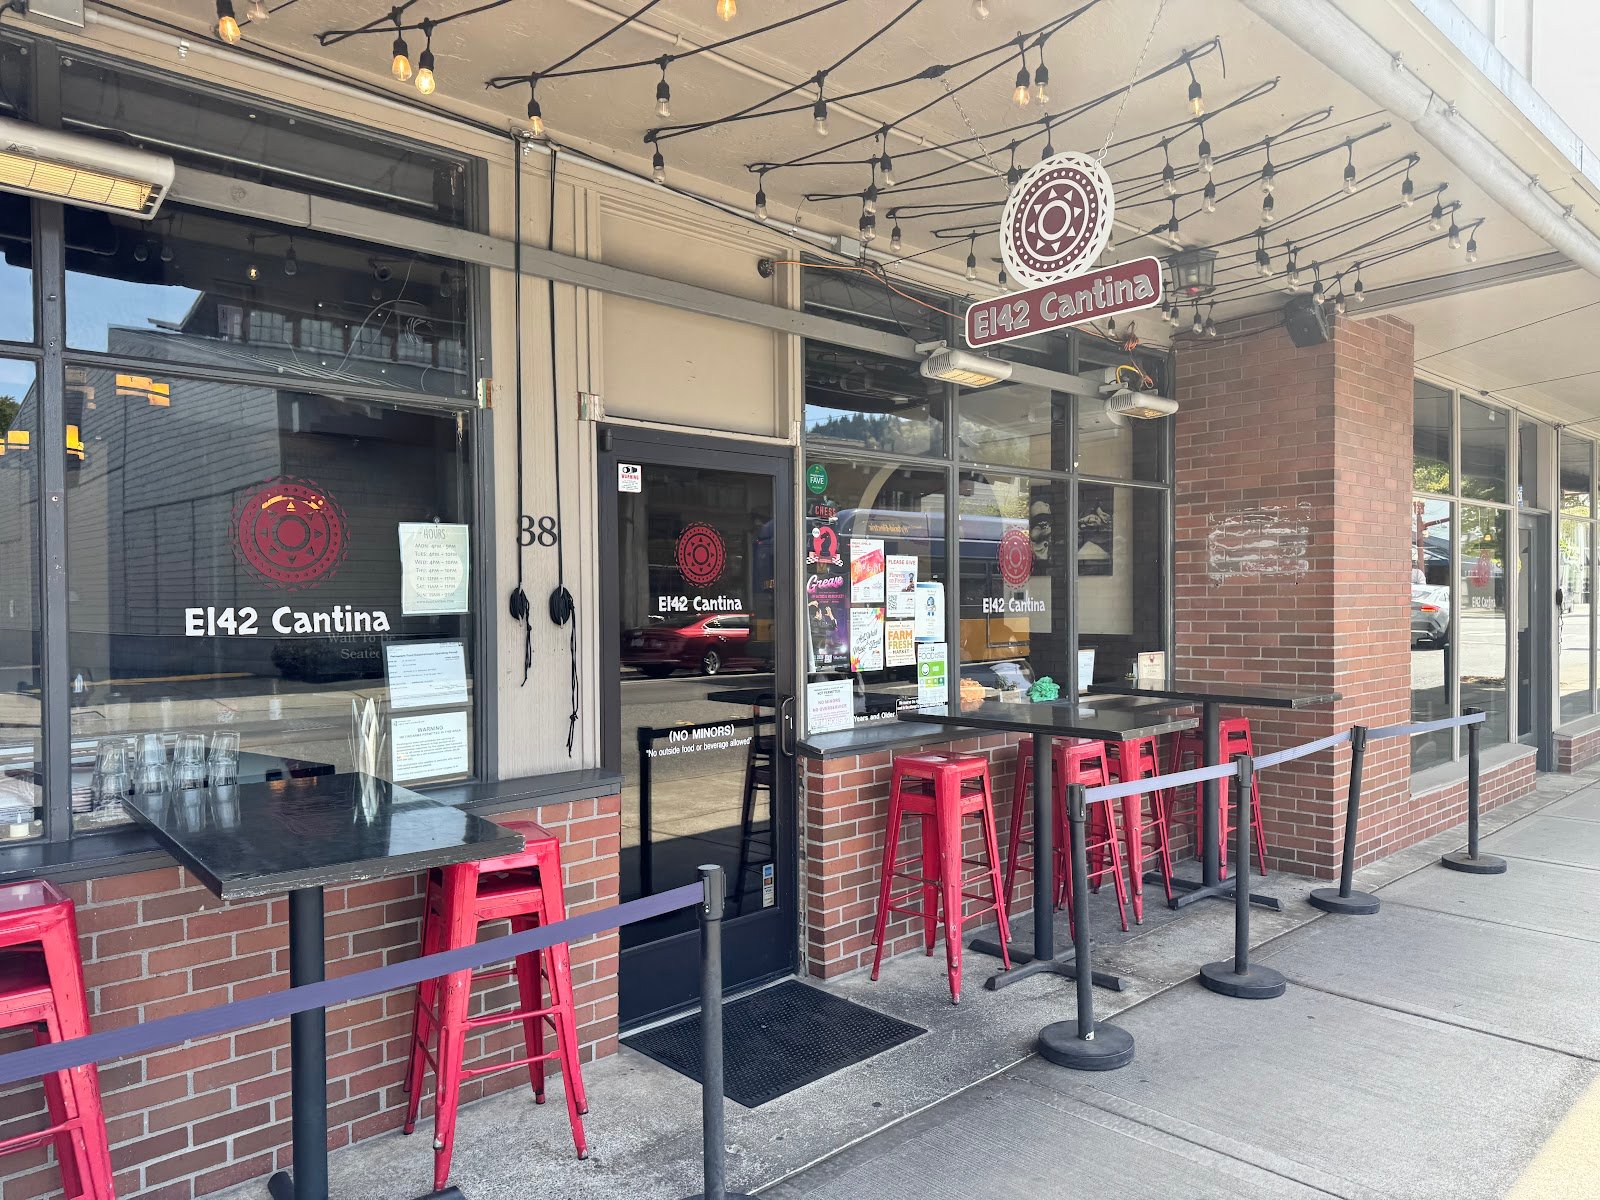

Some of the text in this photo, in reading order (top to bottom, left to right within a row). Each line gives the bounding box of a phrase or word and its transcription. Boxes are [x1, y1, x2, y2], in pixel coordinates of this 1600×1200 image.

[974, 273, 1155, 340] El42 Cantina
[815, 506, 836, 517] CHESS
[423, 528, 446, 540] HOURS
[516, 514, 558, 547] 38
[806, 574, 843, 593] Grease
[658, 595, 742, 612] El42 Cantina
[982, 597, 1045, 613] El42 Cantina
[185, 605, 390, 636] El42 Cantina
[328, 633, 357, 643] Wait
[361, 633, 376, 643] To
[888, 630, 912, 640] FARM
[888, 640, 912, 650] FRESH
[669, 724, 734, 744] (NO MINORS)
[659, 746, 680, 756] outside
[682, 744, 695, 754] food
[704, 740, 729, 751] beverage
